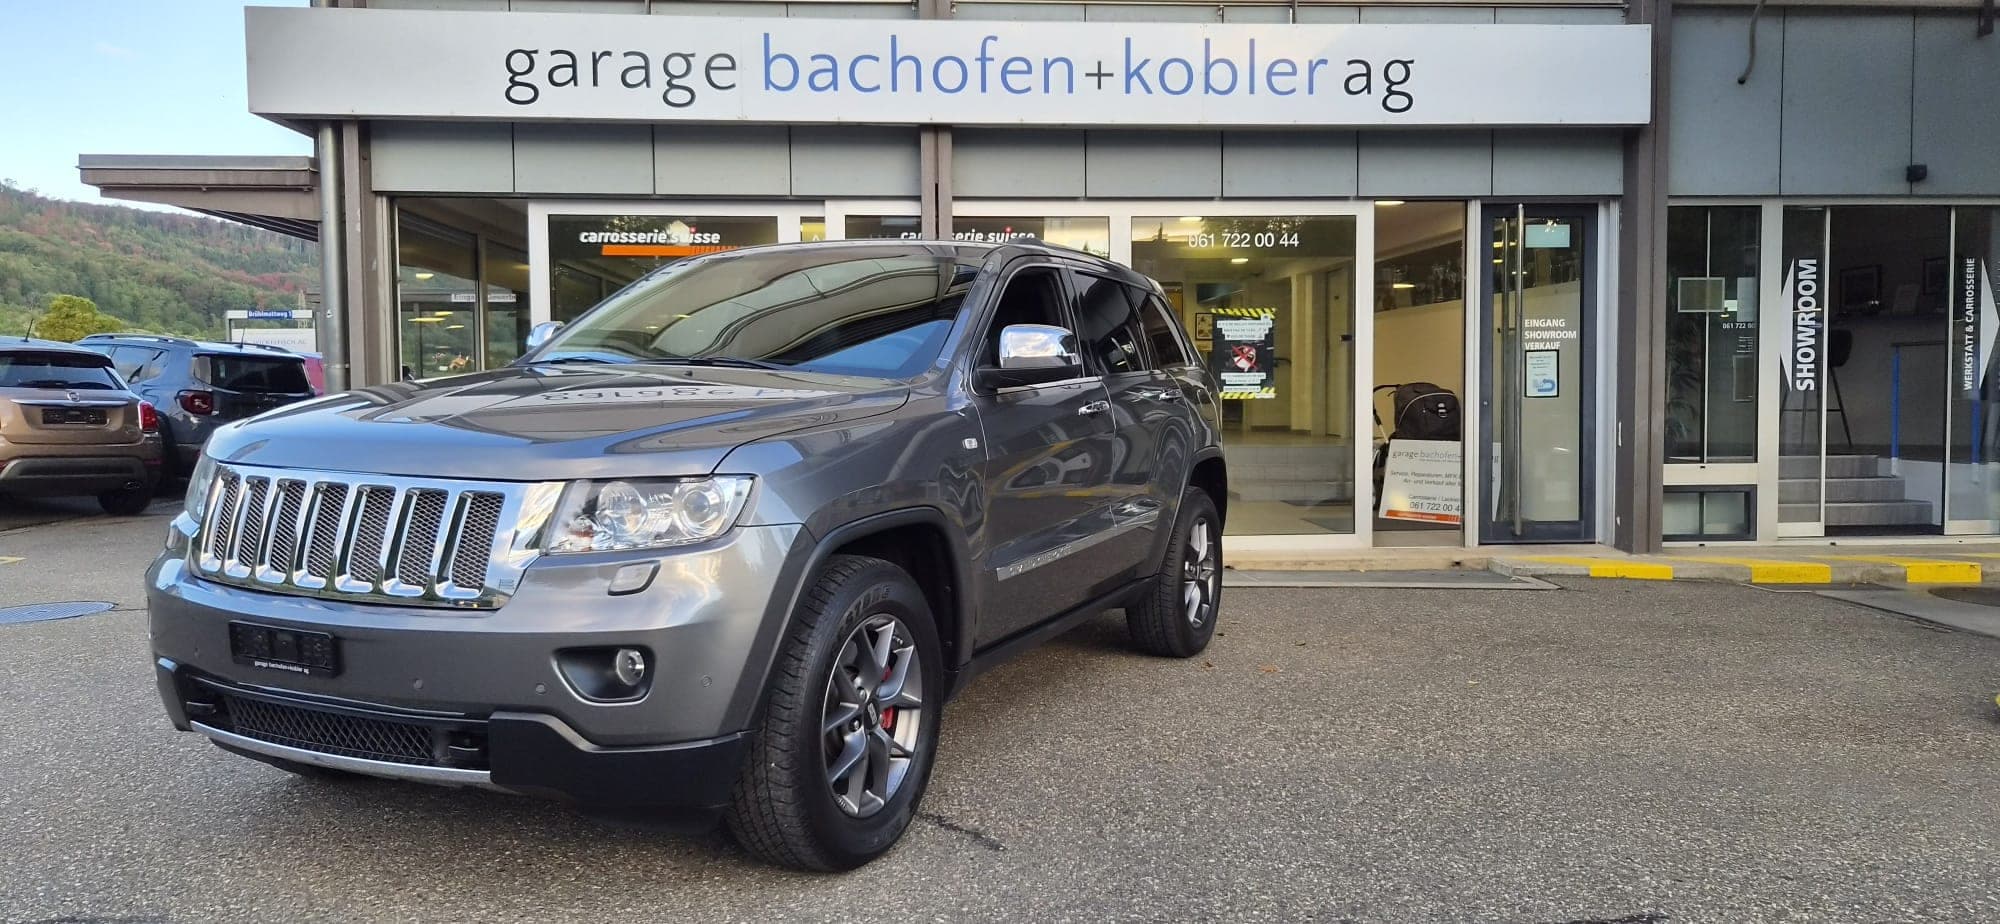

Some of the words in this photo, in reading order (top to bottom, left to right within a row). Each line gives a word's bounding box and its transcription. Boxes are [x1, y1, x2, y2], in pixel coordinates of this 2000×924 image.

[504, 48, 738, 108] garage
[762, 32, 1329, 96] bachofen+kobler
[1343, 57, 1415, 113] ag
[579, 229, 667, 244] carrosserie
[1188, 233, 1216, 248] 061
[1222, 233, 1250, 248] 722
[1254, 233, 1275, 248] 00
[1279, 233, 1299, 248] 44
[1965, 257, 1976, 323] CARROSSERIE
[1524, 318, 1566, 328] EINGANG
[1796, 258, 1817, 392] SHOWROOM
[1965, 324, 1975, 333] &
[1524, 330, 1577, 340] SHOWROOM
[1524, 341, 1561, 350] VERKAUF
[1963, 334, 1975, 391] WERKSTATT
[1392, 451, 1419, 460] garage
[1426, 502, 1441, 511] 722
[1442, 503, 1453, 512] 00
